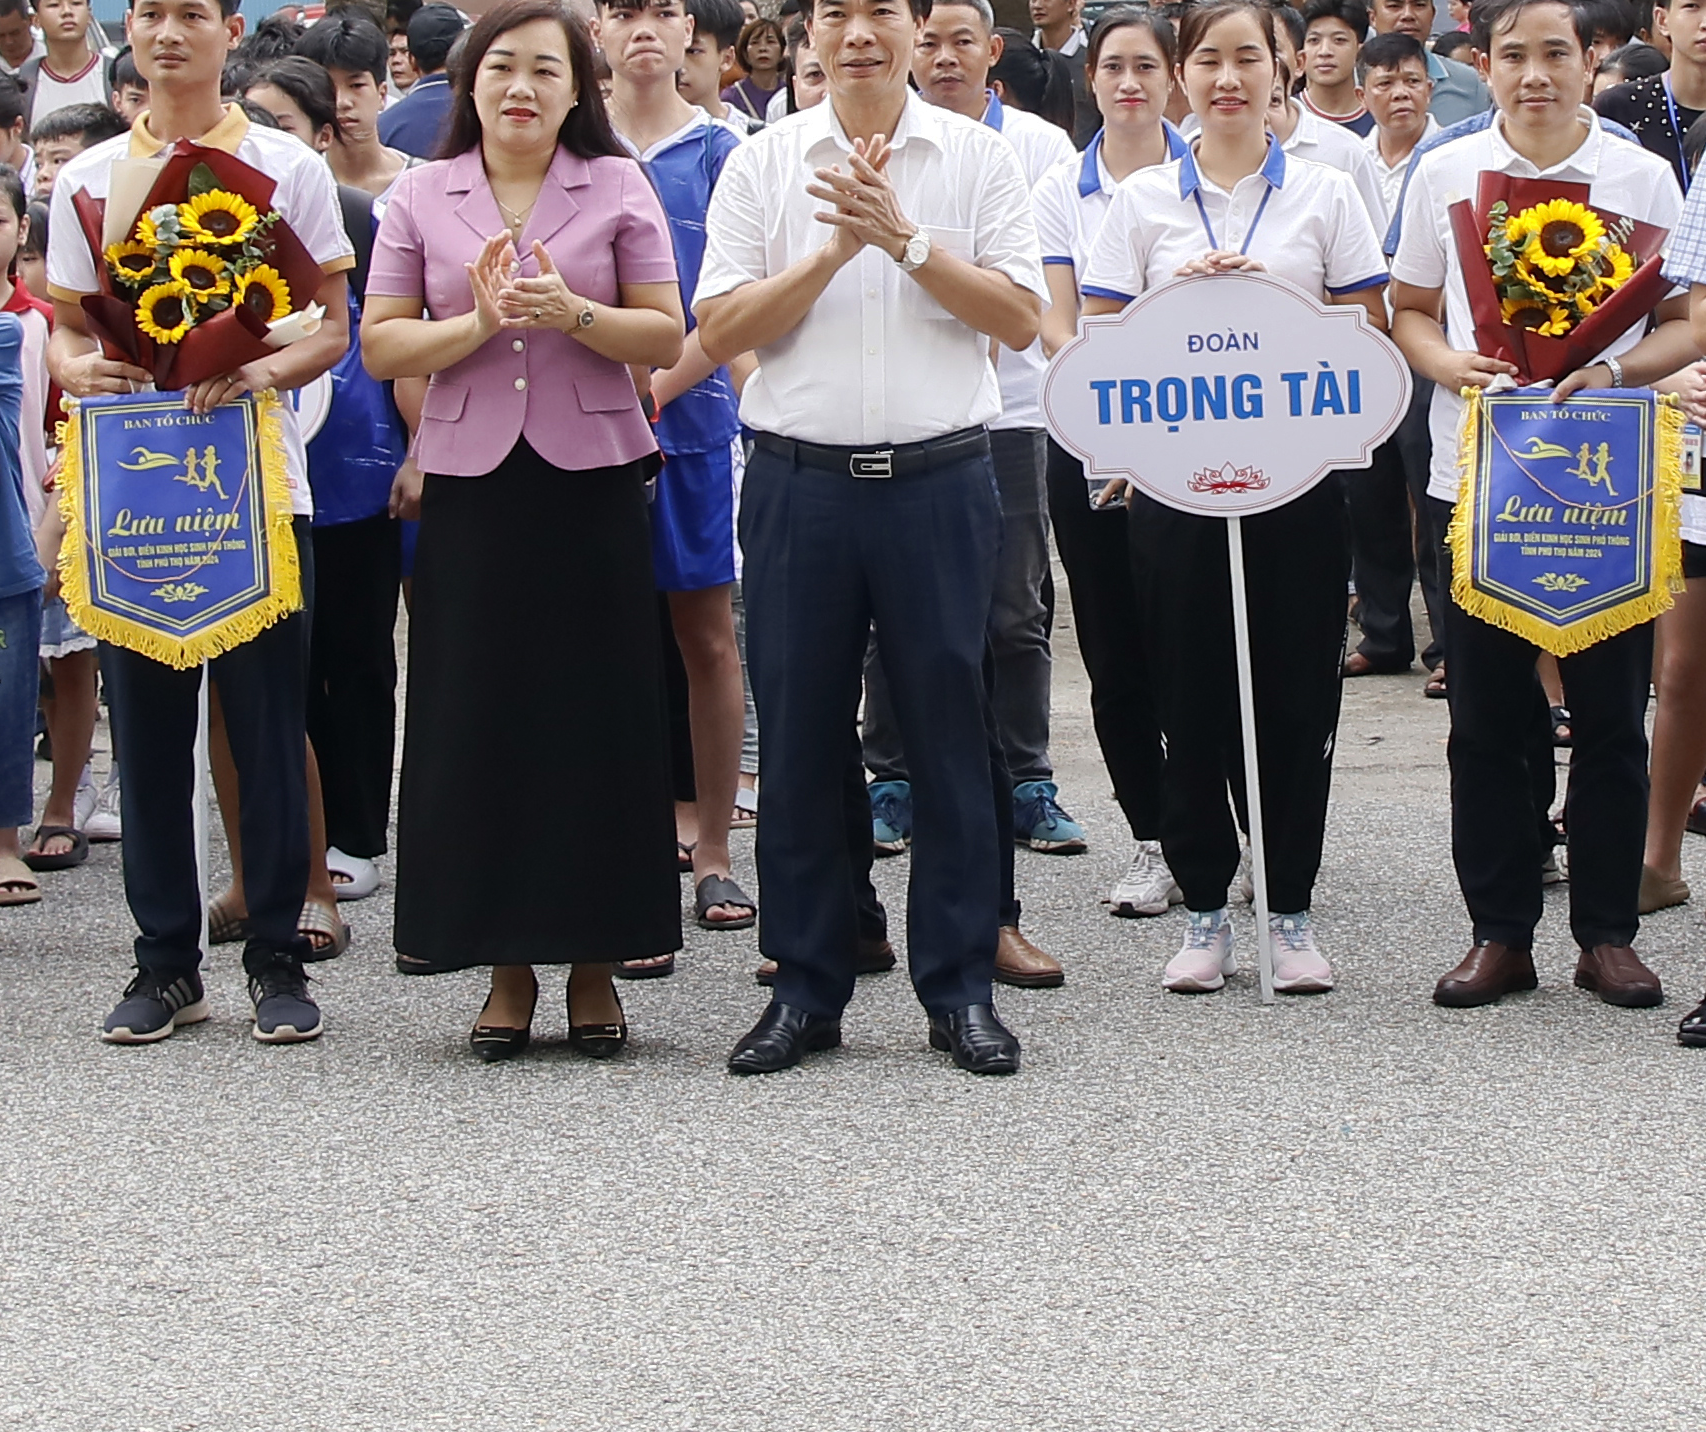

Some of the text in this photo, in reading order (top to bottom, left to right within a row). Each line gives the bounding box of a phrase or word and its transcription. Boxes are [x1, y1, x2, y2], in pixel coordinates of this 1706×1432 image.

[1187, 327, 1260, 353] ĐOÀN
[1089, 361, 1362, 433] TRỌNG TÀI
[124, 418, 152, 429] BAN
[154, 413, 173, 427] TỔ
[1521, 406, 1611, 422] BAN TỔ CHỨC
[107, 507, 241, 537] Lưu niệm
[1495, 494, 1628, 531] Lưu niệm
